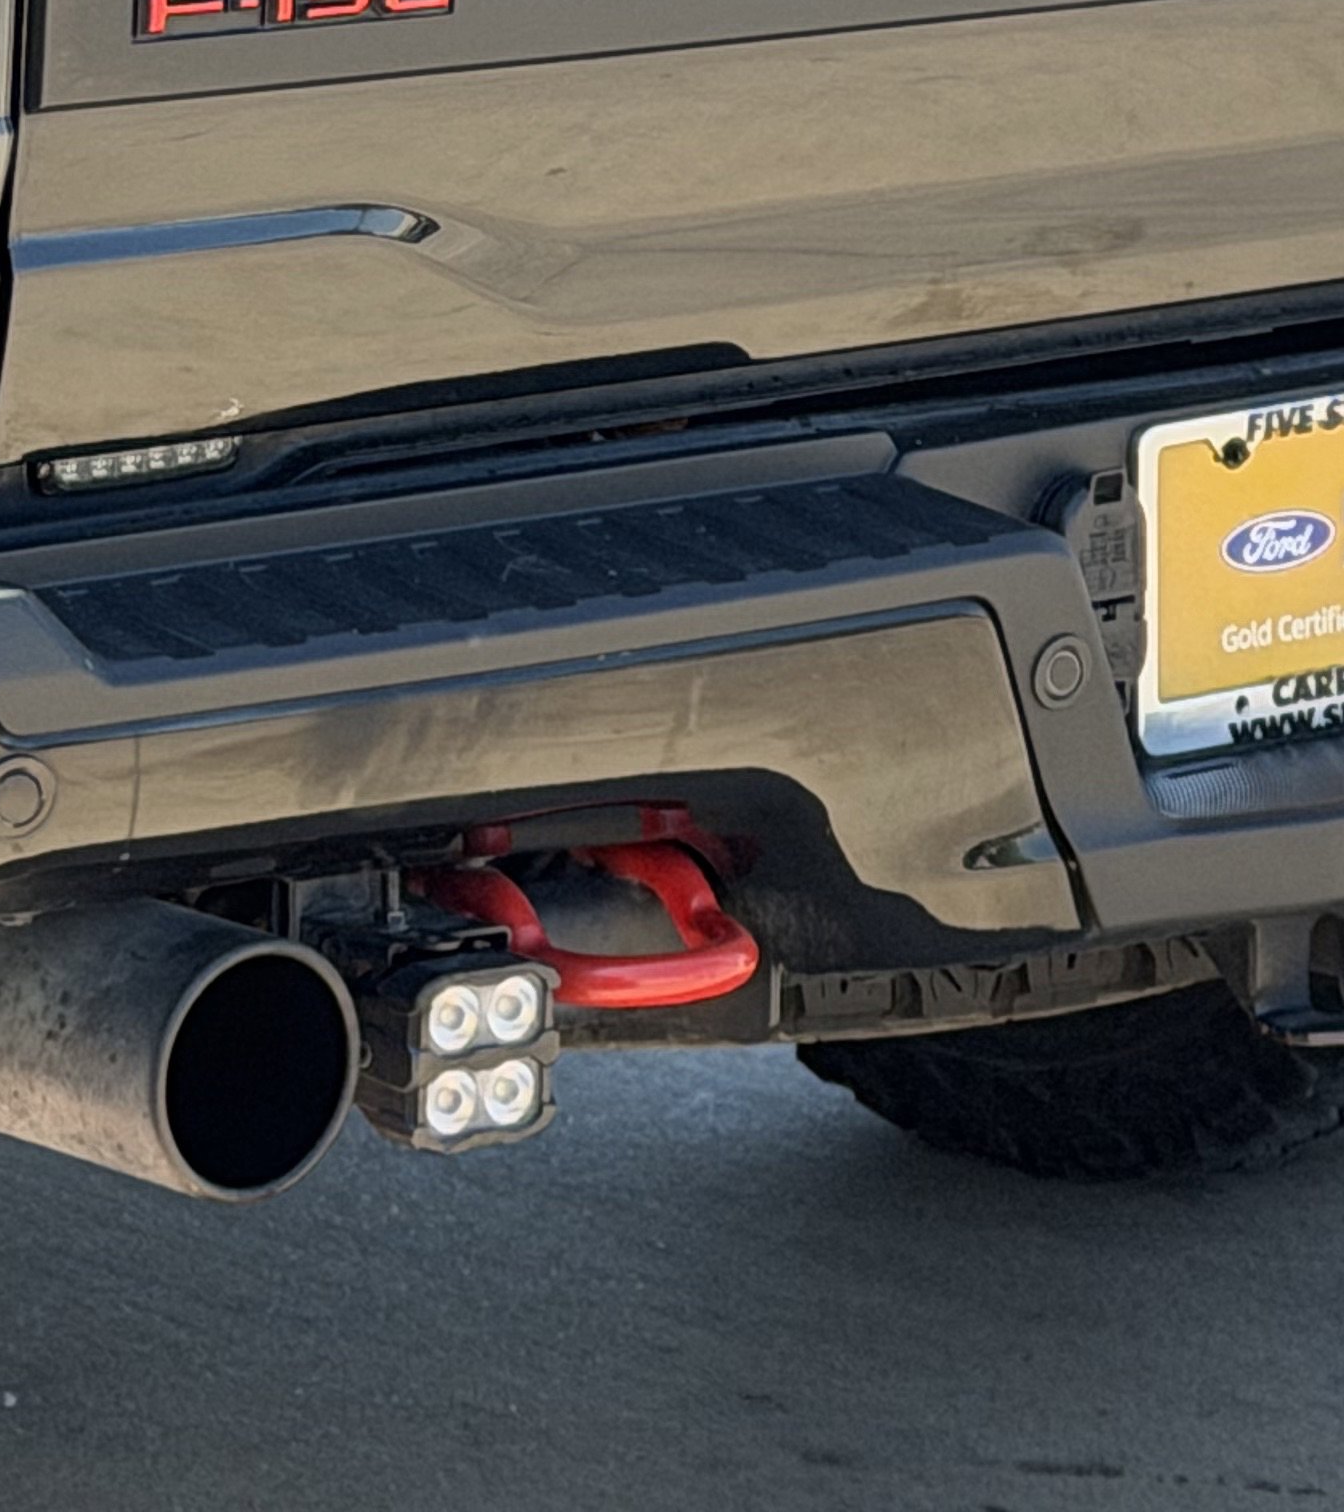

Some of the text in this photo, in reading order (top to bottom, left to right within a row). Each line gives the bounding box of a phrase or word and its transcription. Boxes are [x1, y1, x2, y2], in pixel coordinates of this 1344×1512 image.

[1246, 405, 1313, 442] FIVE
[1242, 518, 1313, 565] Ford
[1221, 618, 1273, 653] Gold
